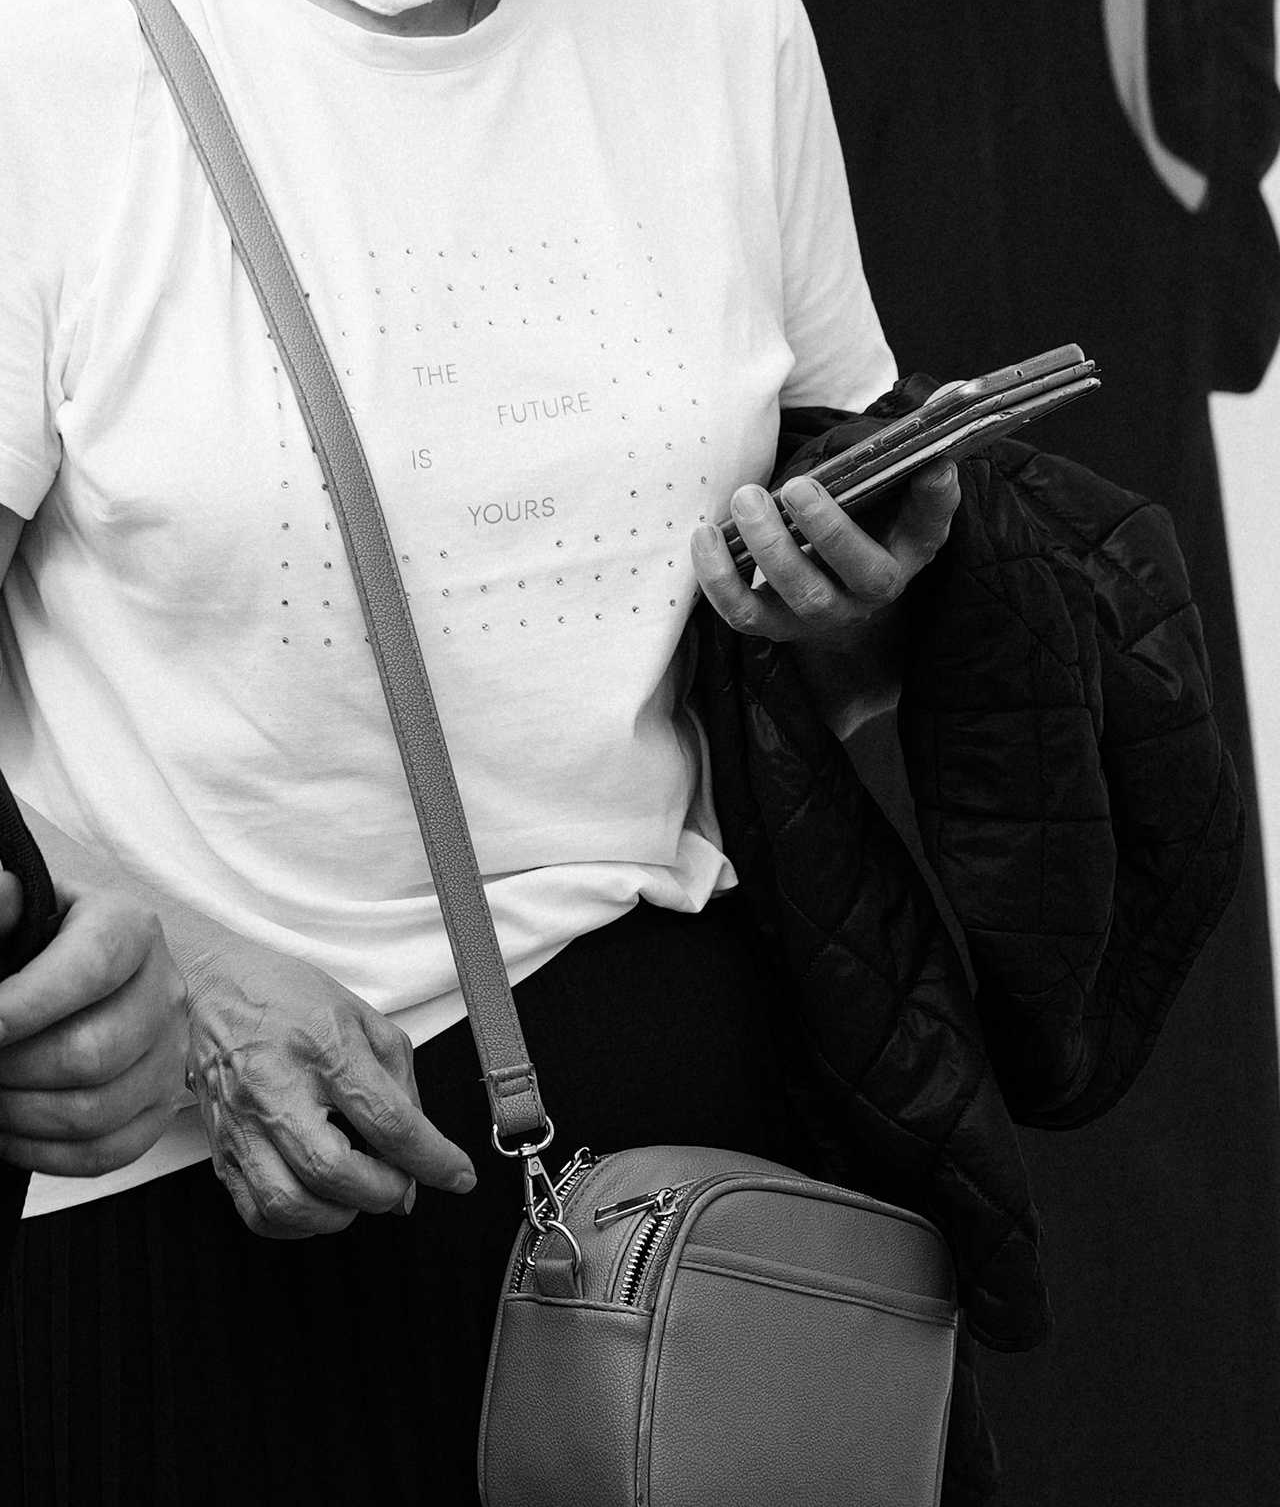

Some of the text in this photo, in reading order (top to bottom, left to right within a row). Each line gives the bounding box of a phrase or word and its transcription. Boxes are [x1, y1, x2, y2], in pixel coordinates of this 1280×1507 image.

[412, 363, 459, 386] THE
[497, 392, 592, 425] FUTURE
[412, 448, 432, 470] IS
[467, 496, 556, 526] YOURS
